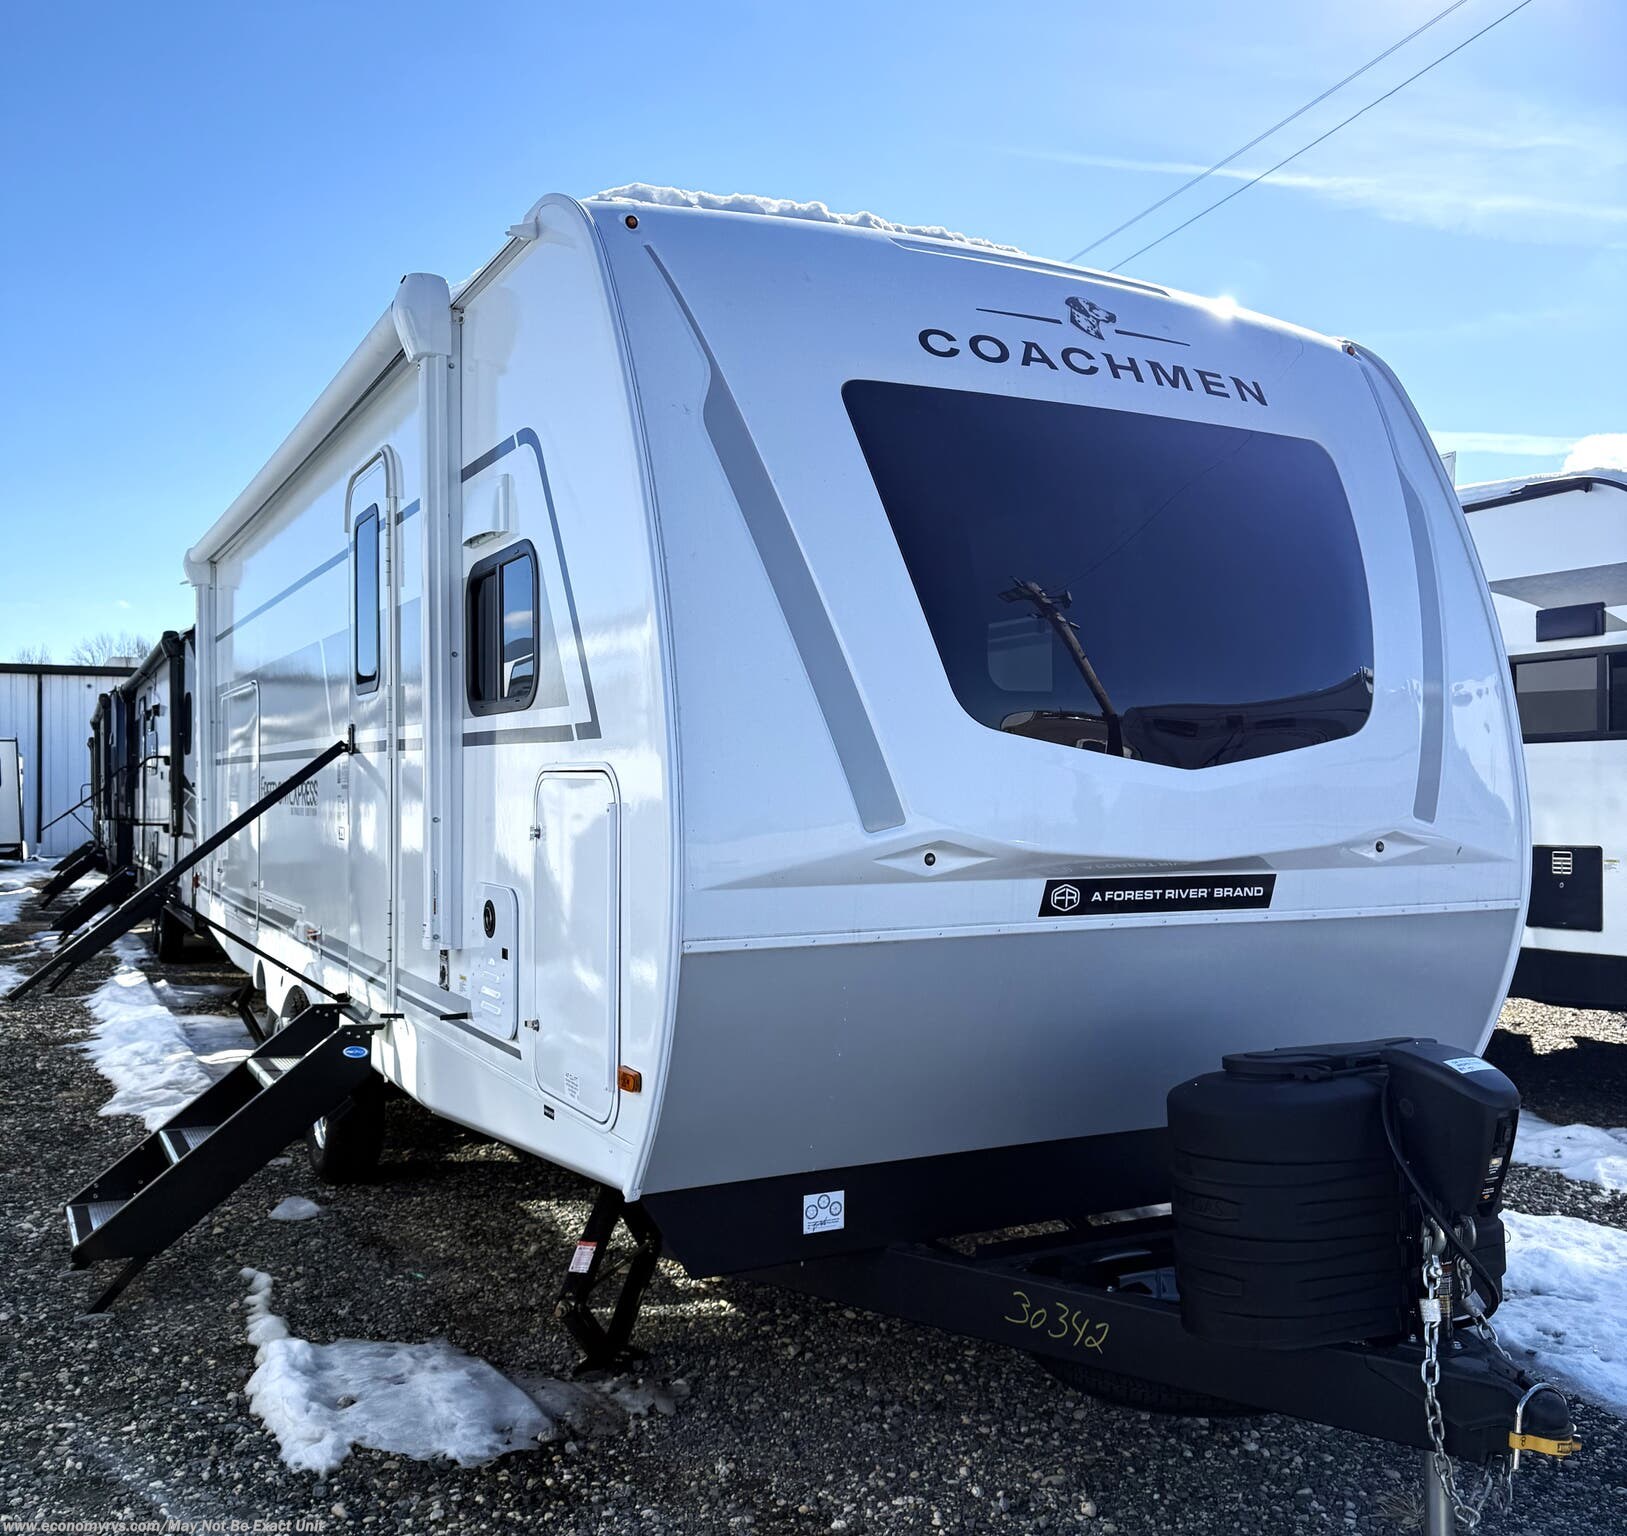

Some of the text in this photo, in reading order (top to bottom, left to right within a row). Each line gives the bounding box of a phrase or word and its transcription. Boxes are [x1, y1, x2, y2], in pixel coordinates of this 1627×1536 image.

[917, 328, 1269, 406] COACHMEN
[1091, 891, 1103, 902] A
[1104, 889, 1163, 902] FOREST
[1213, 886, 1264, 898] BRAND
[1004, 1291, 1110, 1354] 30342
